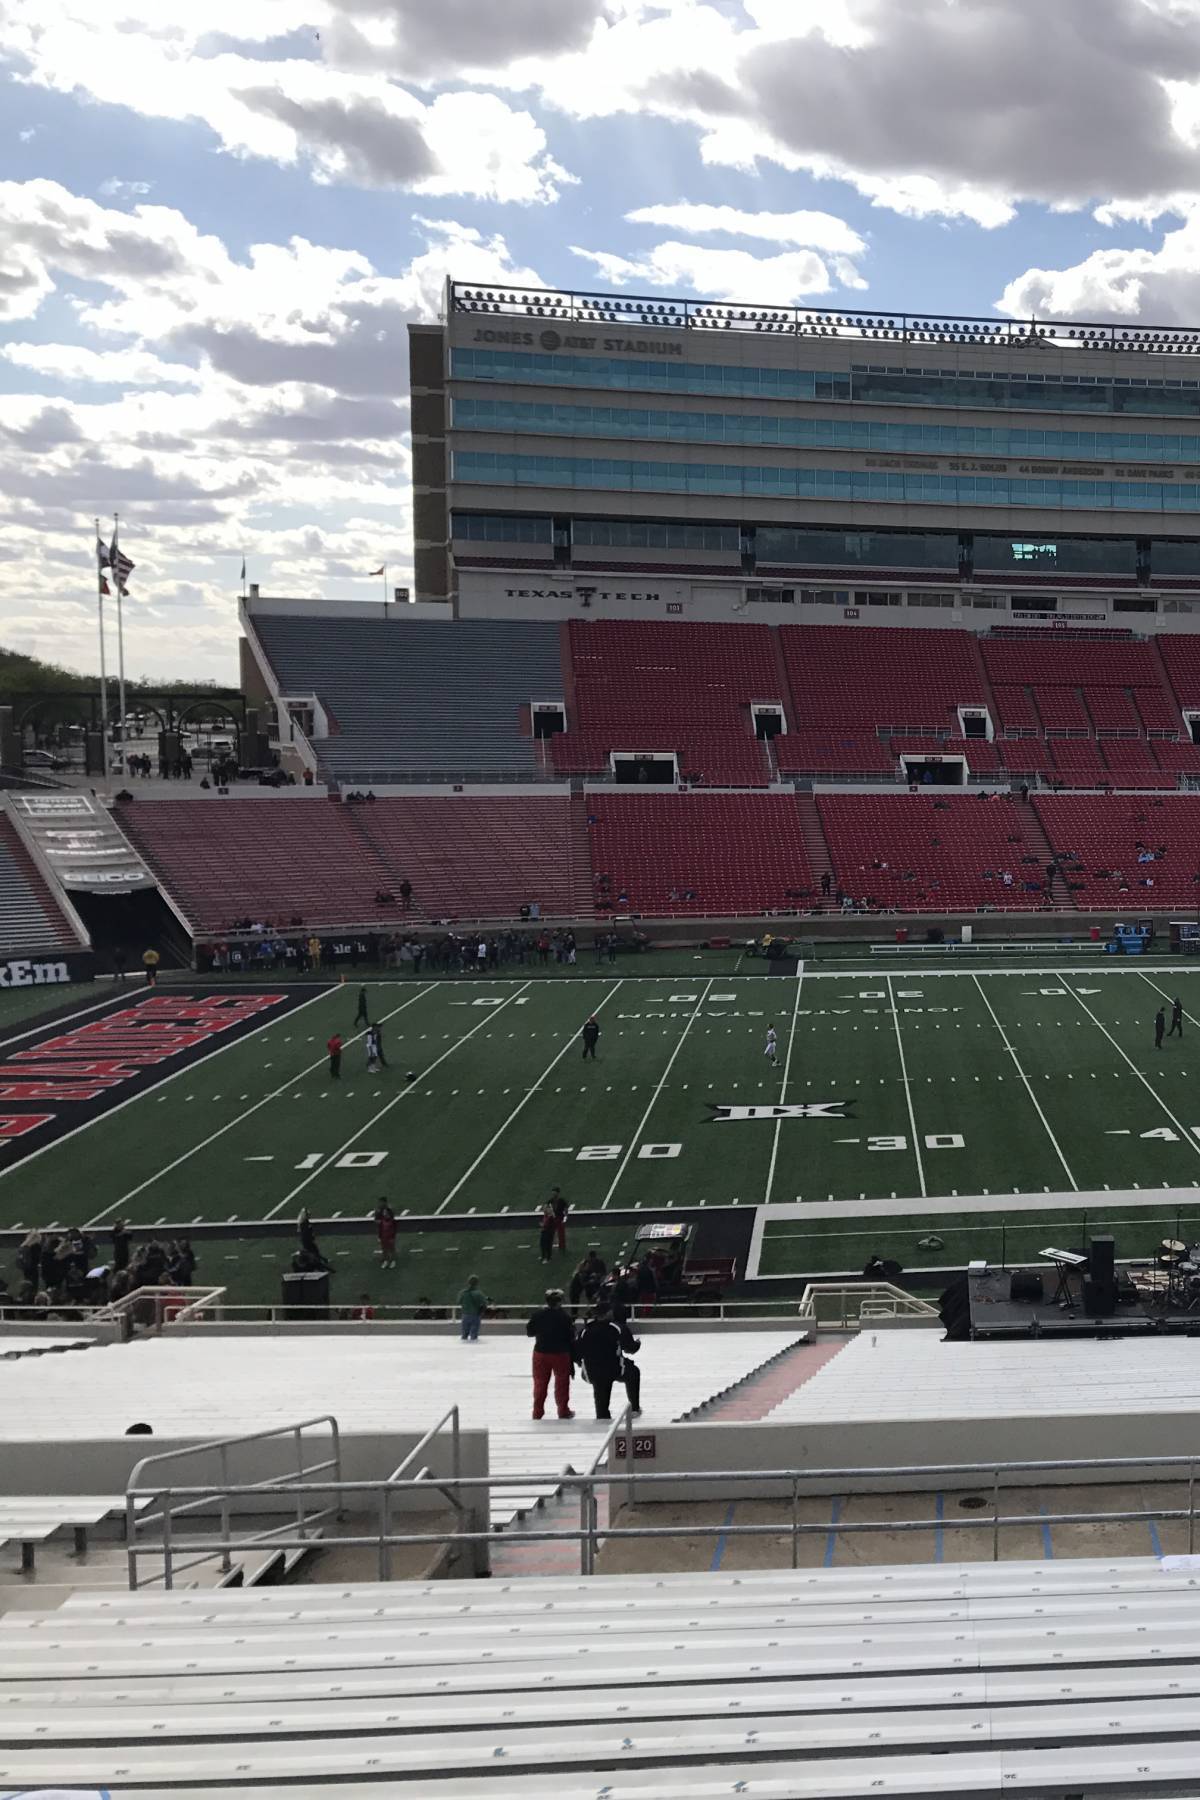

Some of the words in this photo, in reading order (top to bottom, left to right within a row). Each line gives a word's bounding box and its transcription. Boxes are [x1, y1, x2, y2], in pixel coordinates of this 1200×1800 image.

[474, 329, 533, 346] JONES
[563, 336, 597, 350] AT&T
[604, 339, 683, 355] STADIUM
[505, 589, 573, 599] TEXAS
[600, 592, 659, 601] TECH
[868, 1134, 966, 1151] 30
[294, 1152, 389, 1169] 10
[575, 1143, 682, 1161] 20
